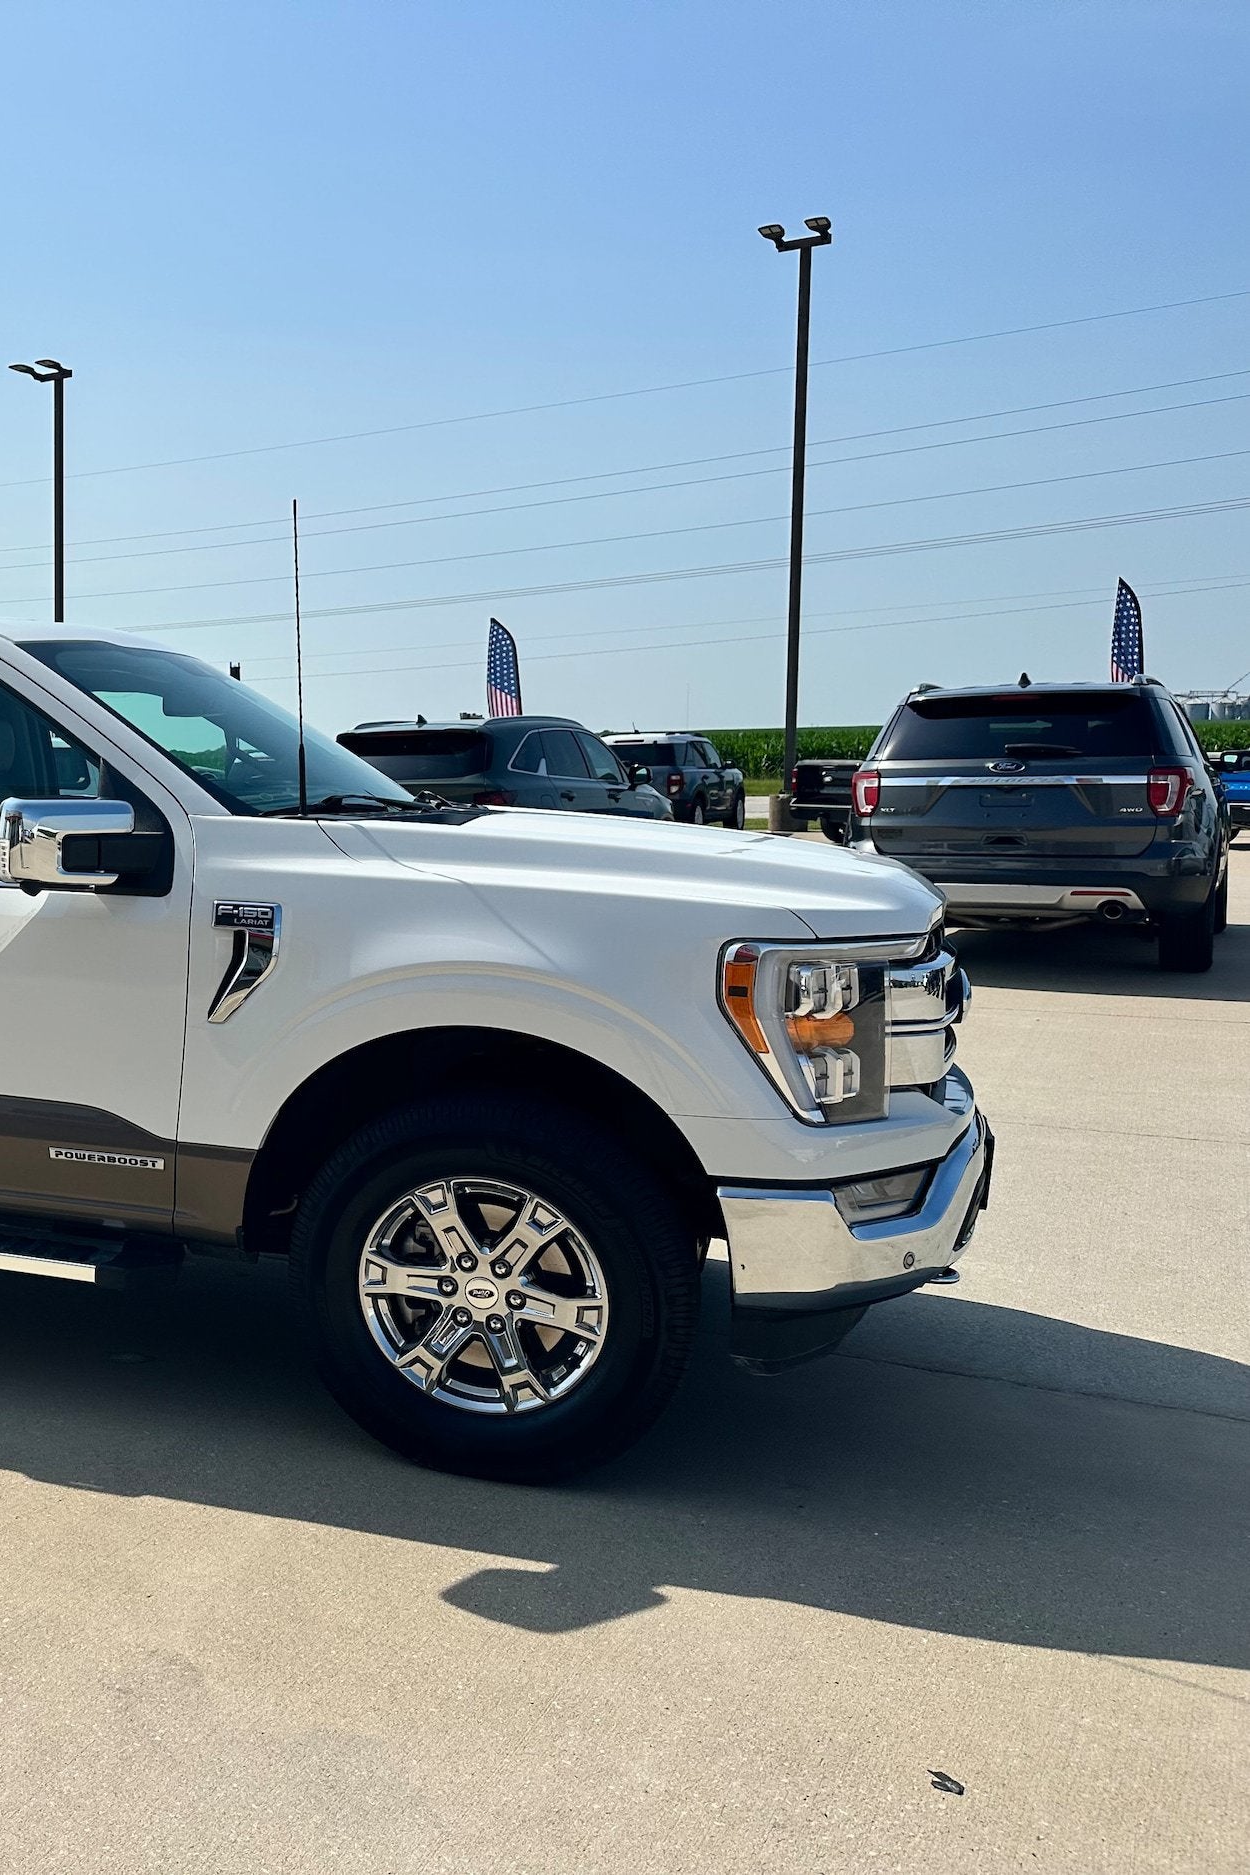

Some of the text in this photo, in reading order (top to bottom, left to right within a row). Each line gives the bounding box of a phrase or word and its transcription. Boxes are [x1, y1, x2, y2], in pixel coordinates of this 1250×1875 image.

[217, 905, 273, 919] F-150
[234, 918, 270, 926] LARIAT
[54, 1150, 158, 1169] POWERBOOST
